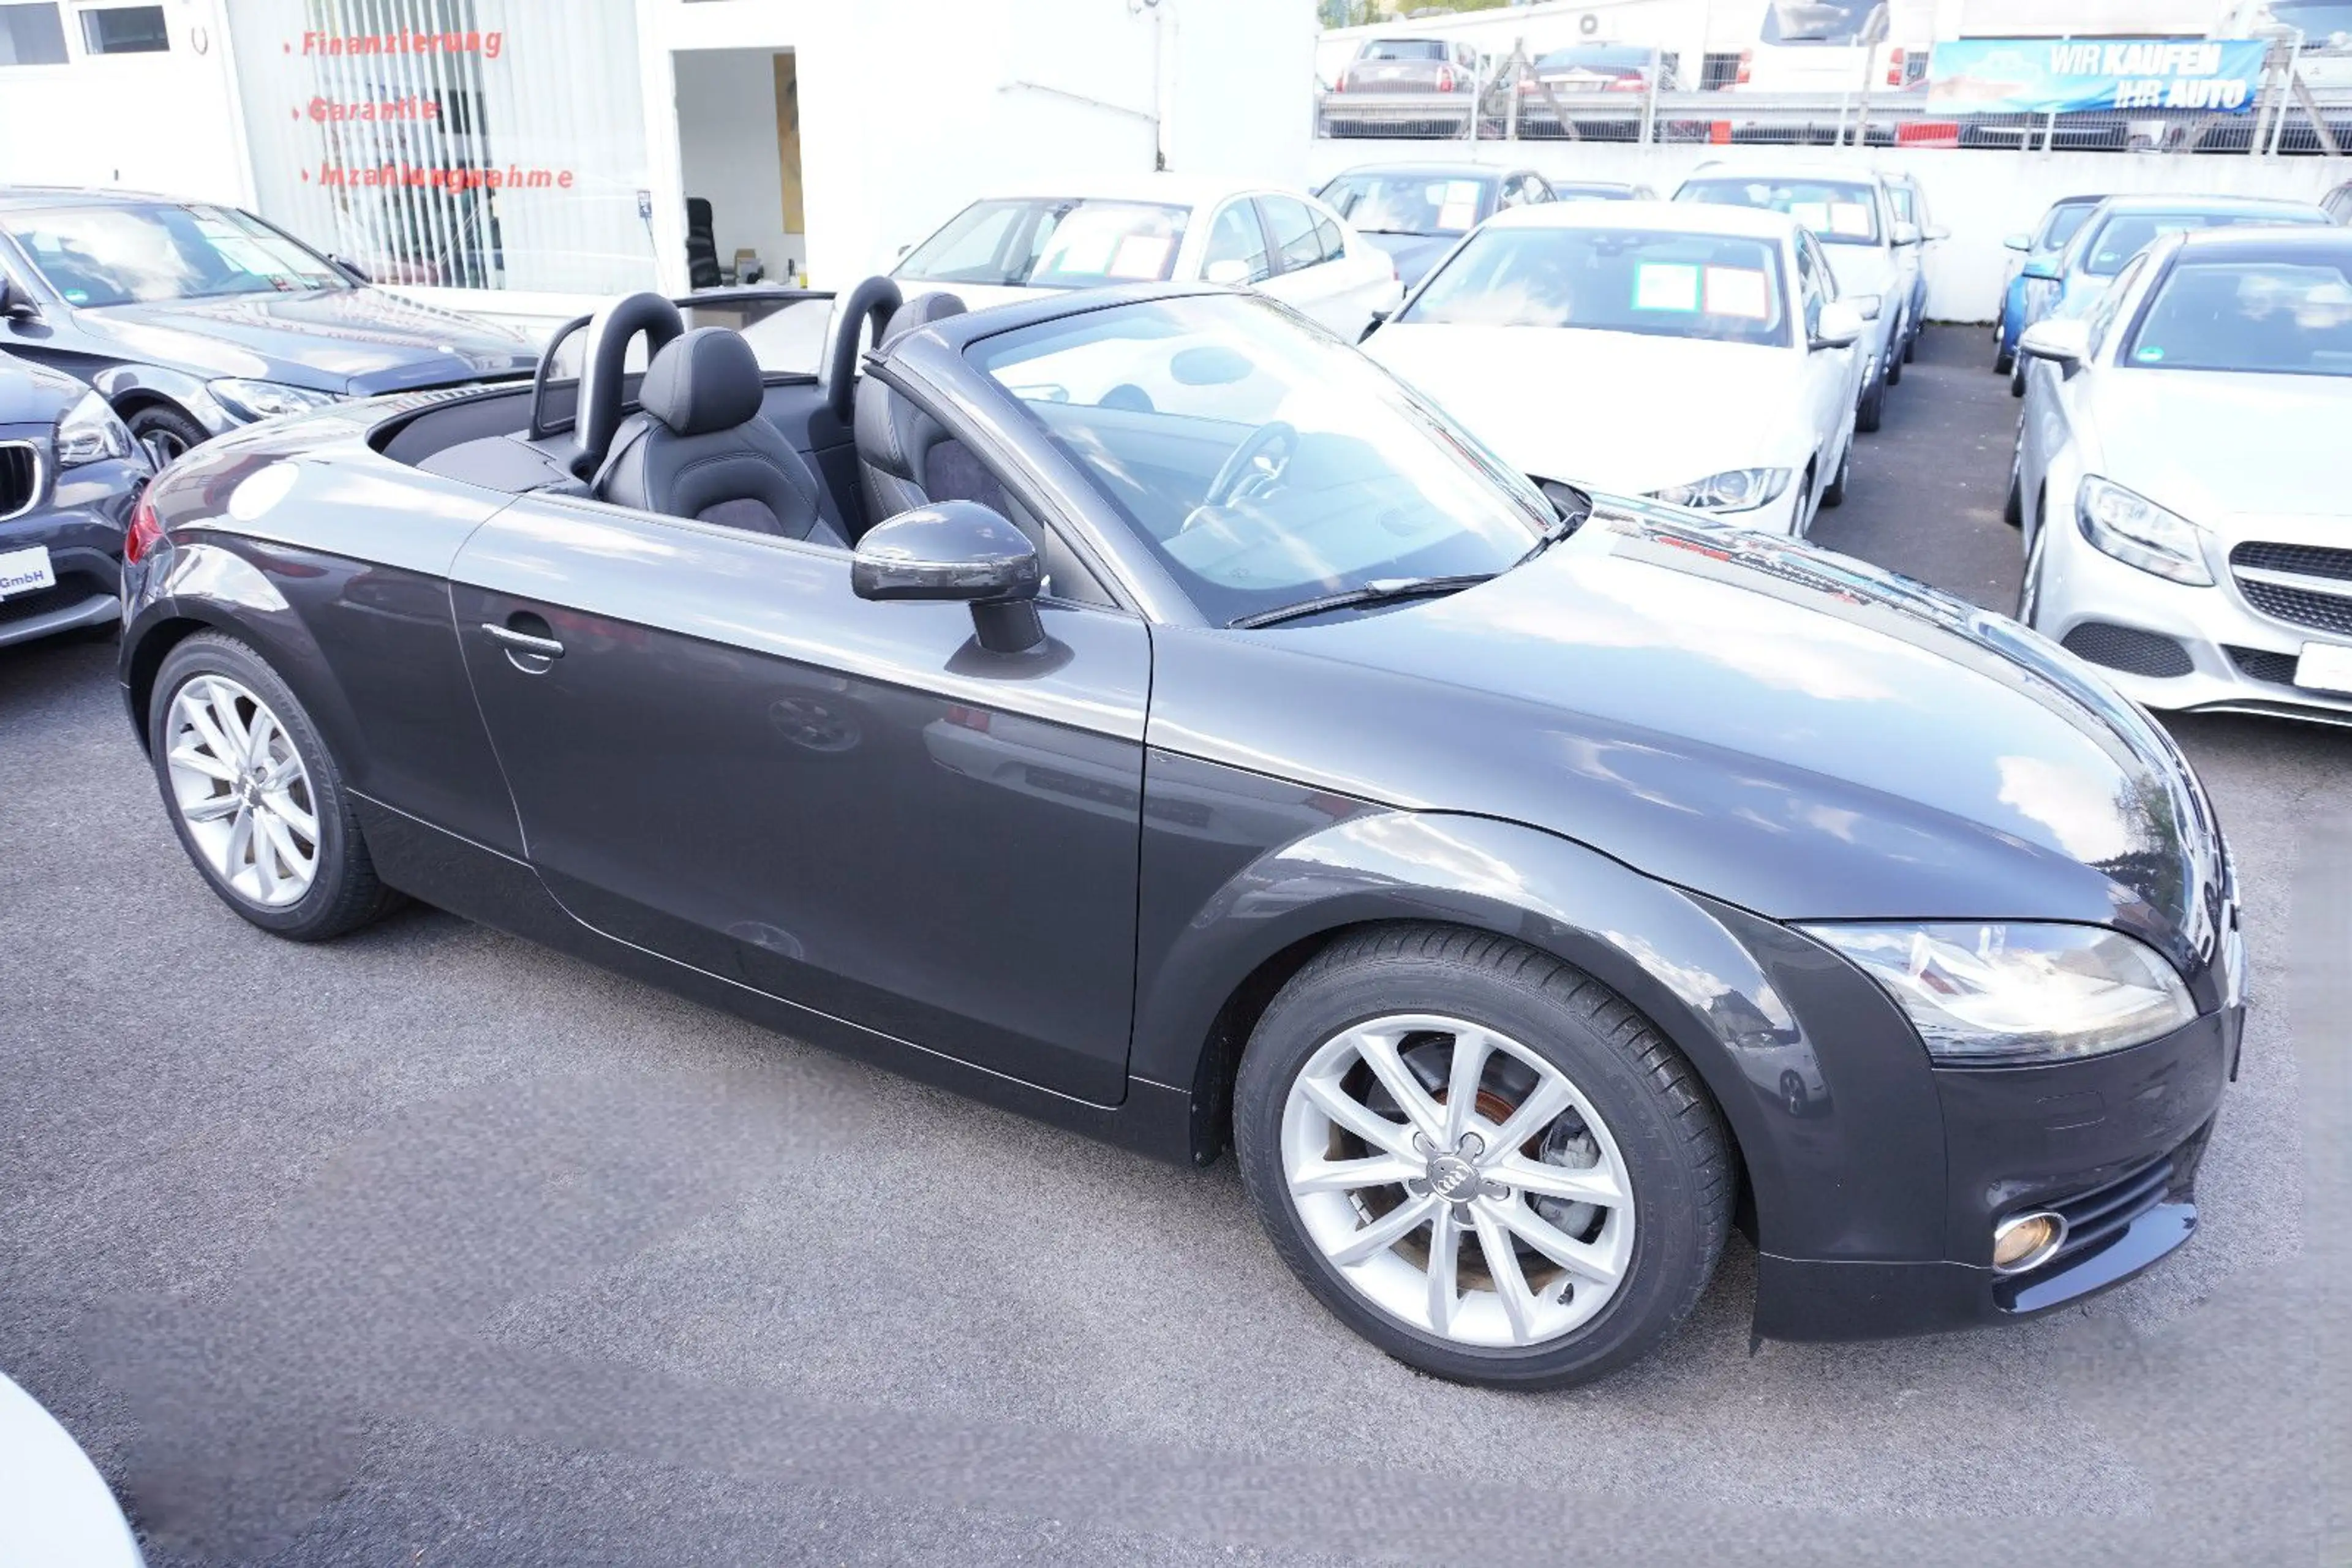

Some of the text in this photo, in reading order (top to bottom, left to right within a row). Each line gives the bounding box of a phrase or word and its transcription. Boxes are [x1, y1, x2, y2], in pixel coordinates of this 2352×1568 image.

[302, 26, 503, 58] Finanzierung
[2051, 43, 2222, 75] WIR KAUFEN
[308, 94, 439, 123] Garantie
[2114, 78, 2247, 108] IHR AUTO
[318, 160, 574, 194] Inzahlungnahme
[0, 570, 44, 588] GmbH
